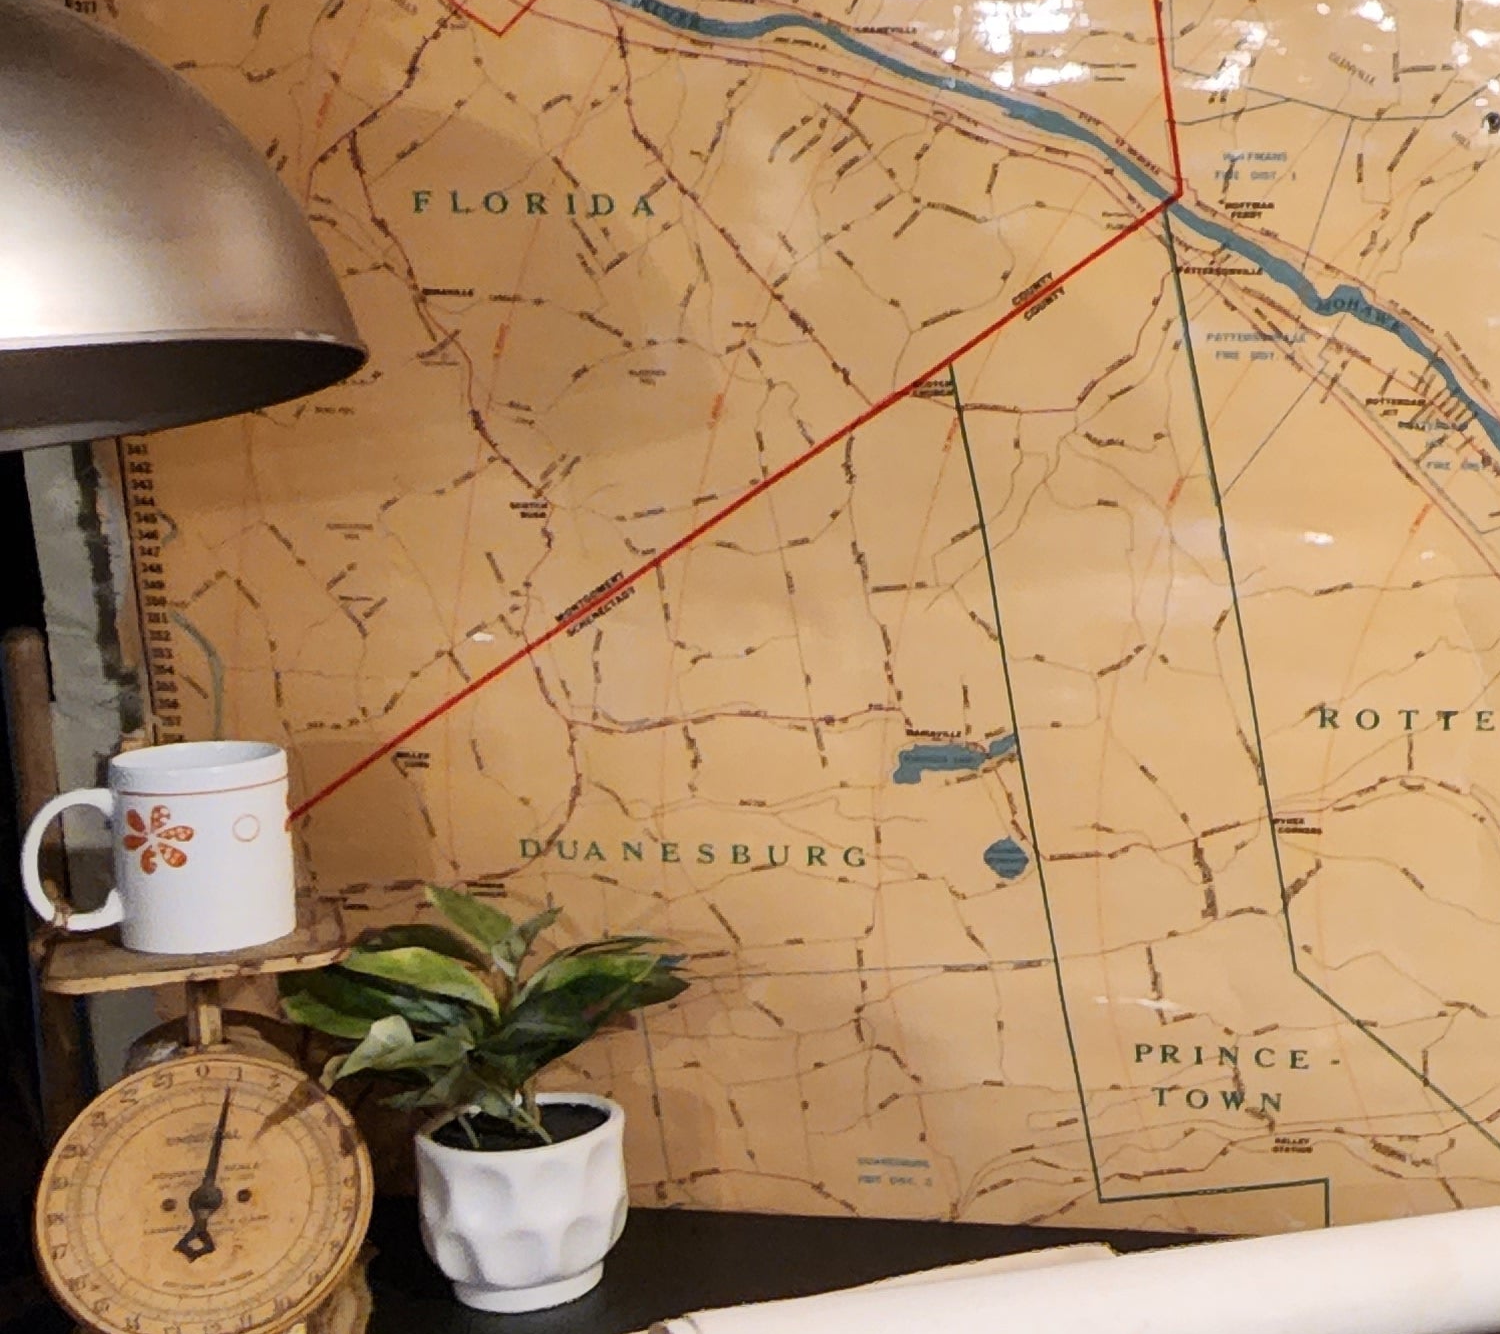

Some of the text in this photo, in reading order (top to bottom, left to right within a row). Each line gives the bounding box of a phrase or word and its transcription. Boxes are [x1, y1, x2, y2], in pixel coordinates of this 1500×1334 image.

[412, 192, 654, 217] FLORIDA
[1012, 271, 1054, 305] COUNTY
[1024, 286, 1066, 321] COUNTY
[519, 837, 868, 867] DUANESBURG
[1152, 1086, 1281, 1112] TOWN
